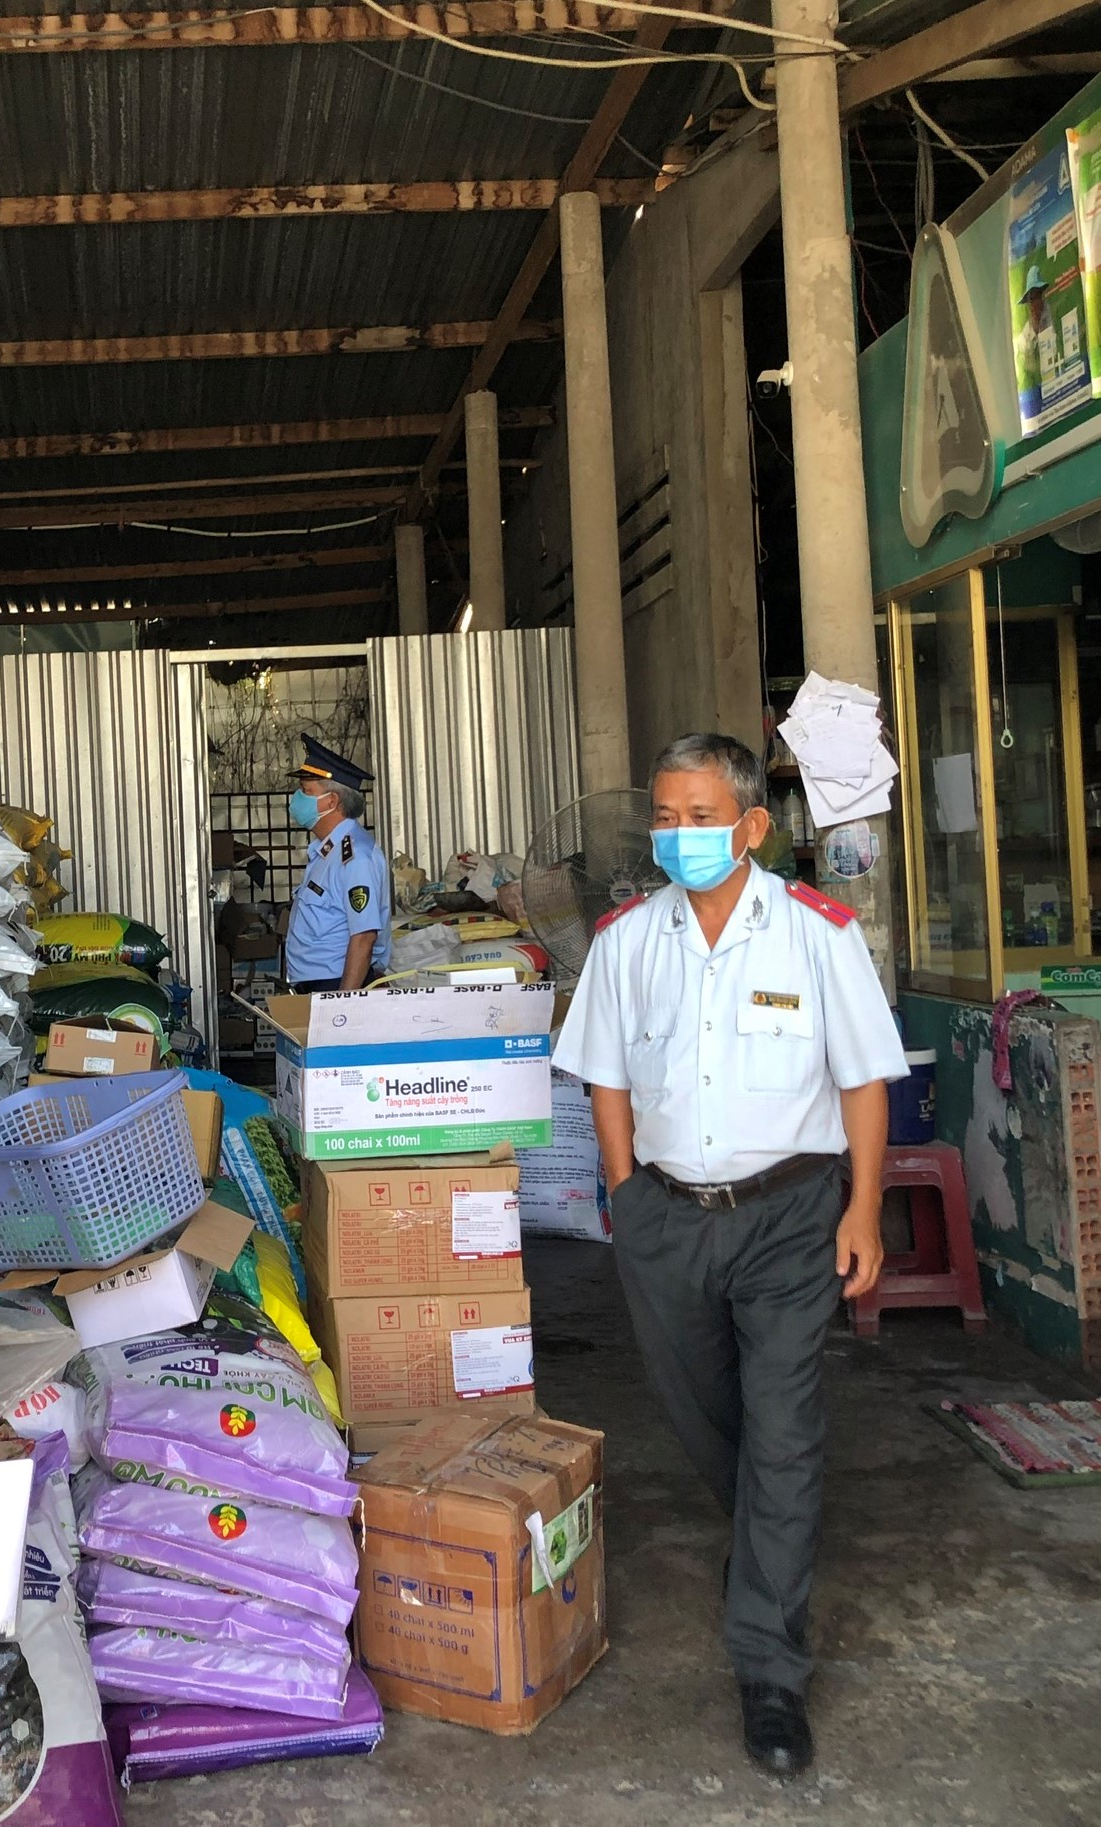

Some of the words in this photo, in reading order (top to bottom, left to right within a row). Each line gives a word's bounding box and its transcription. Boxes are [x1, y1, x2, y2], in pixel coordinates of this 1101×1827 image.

[517, 1037, 543, 1048] BASF
[324, 1138, 345, 1150] 100
[348, 1136, 373, 1149] chai
[375, 1139, 384, 1148] x
[386, 1133, 421, 1147] 100ml
[13, 1384, 61, 1419] HỢP
[387, 1609, 400, 1620] 40
[403, 1613, 425, 1626] chai
[428, 1620, 434, 1628] x
[437, 1620, 457, 1634] 500
[460, 1626, 475, 1638] ml
[388, 1625, 401, 1637] 40
[404, 1629, 426, 1643] chai
[429, 1636, 435, 1646] x
[438, 1637, 458, 1651] 500
[461, 1644, 469, 1656] g
